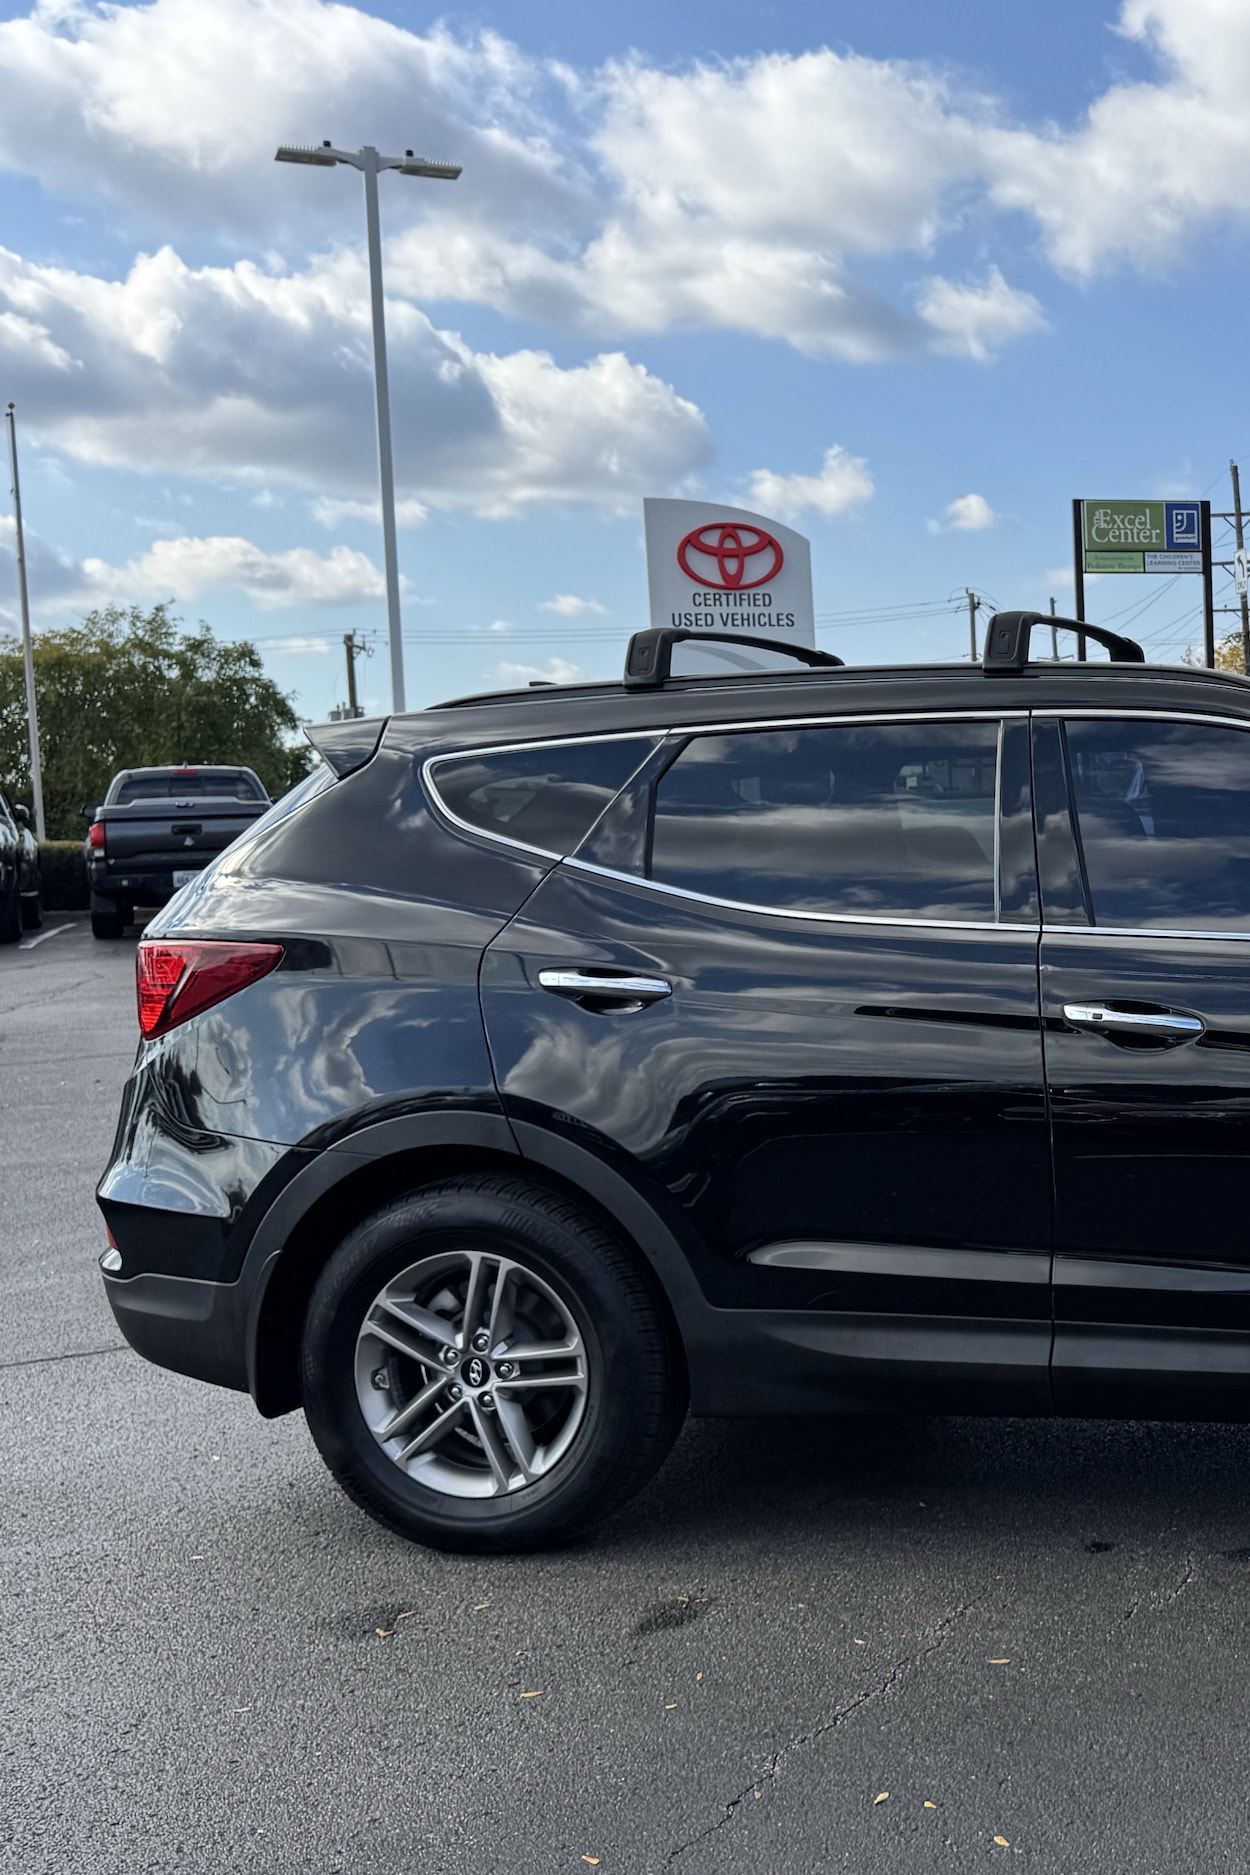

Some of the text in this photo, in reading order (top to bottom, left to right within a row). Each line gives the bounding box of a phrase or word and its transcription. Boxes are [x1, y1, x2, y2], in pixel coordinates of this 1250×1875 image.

[1098, 508, 1151, 529] Excel
[1091, 523, 1160, 543] Center
[692, 592, 772, 607] CERTIFIED
[672, 613, 795, 627] USED VEHICLES
